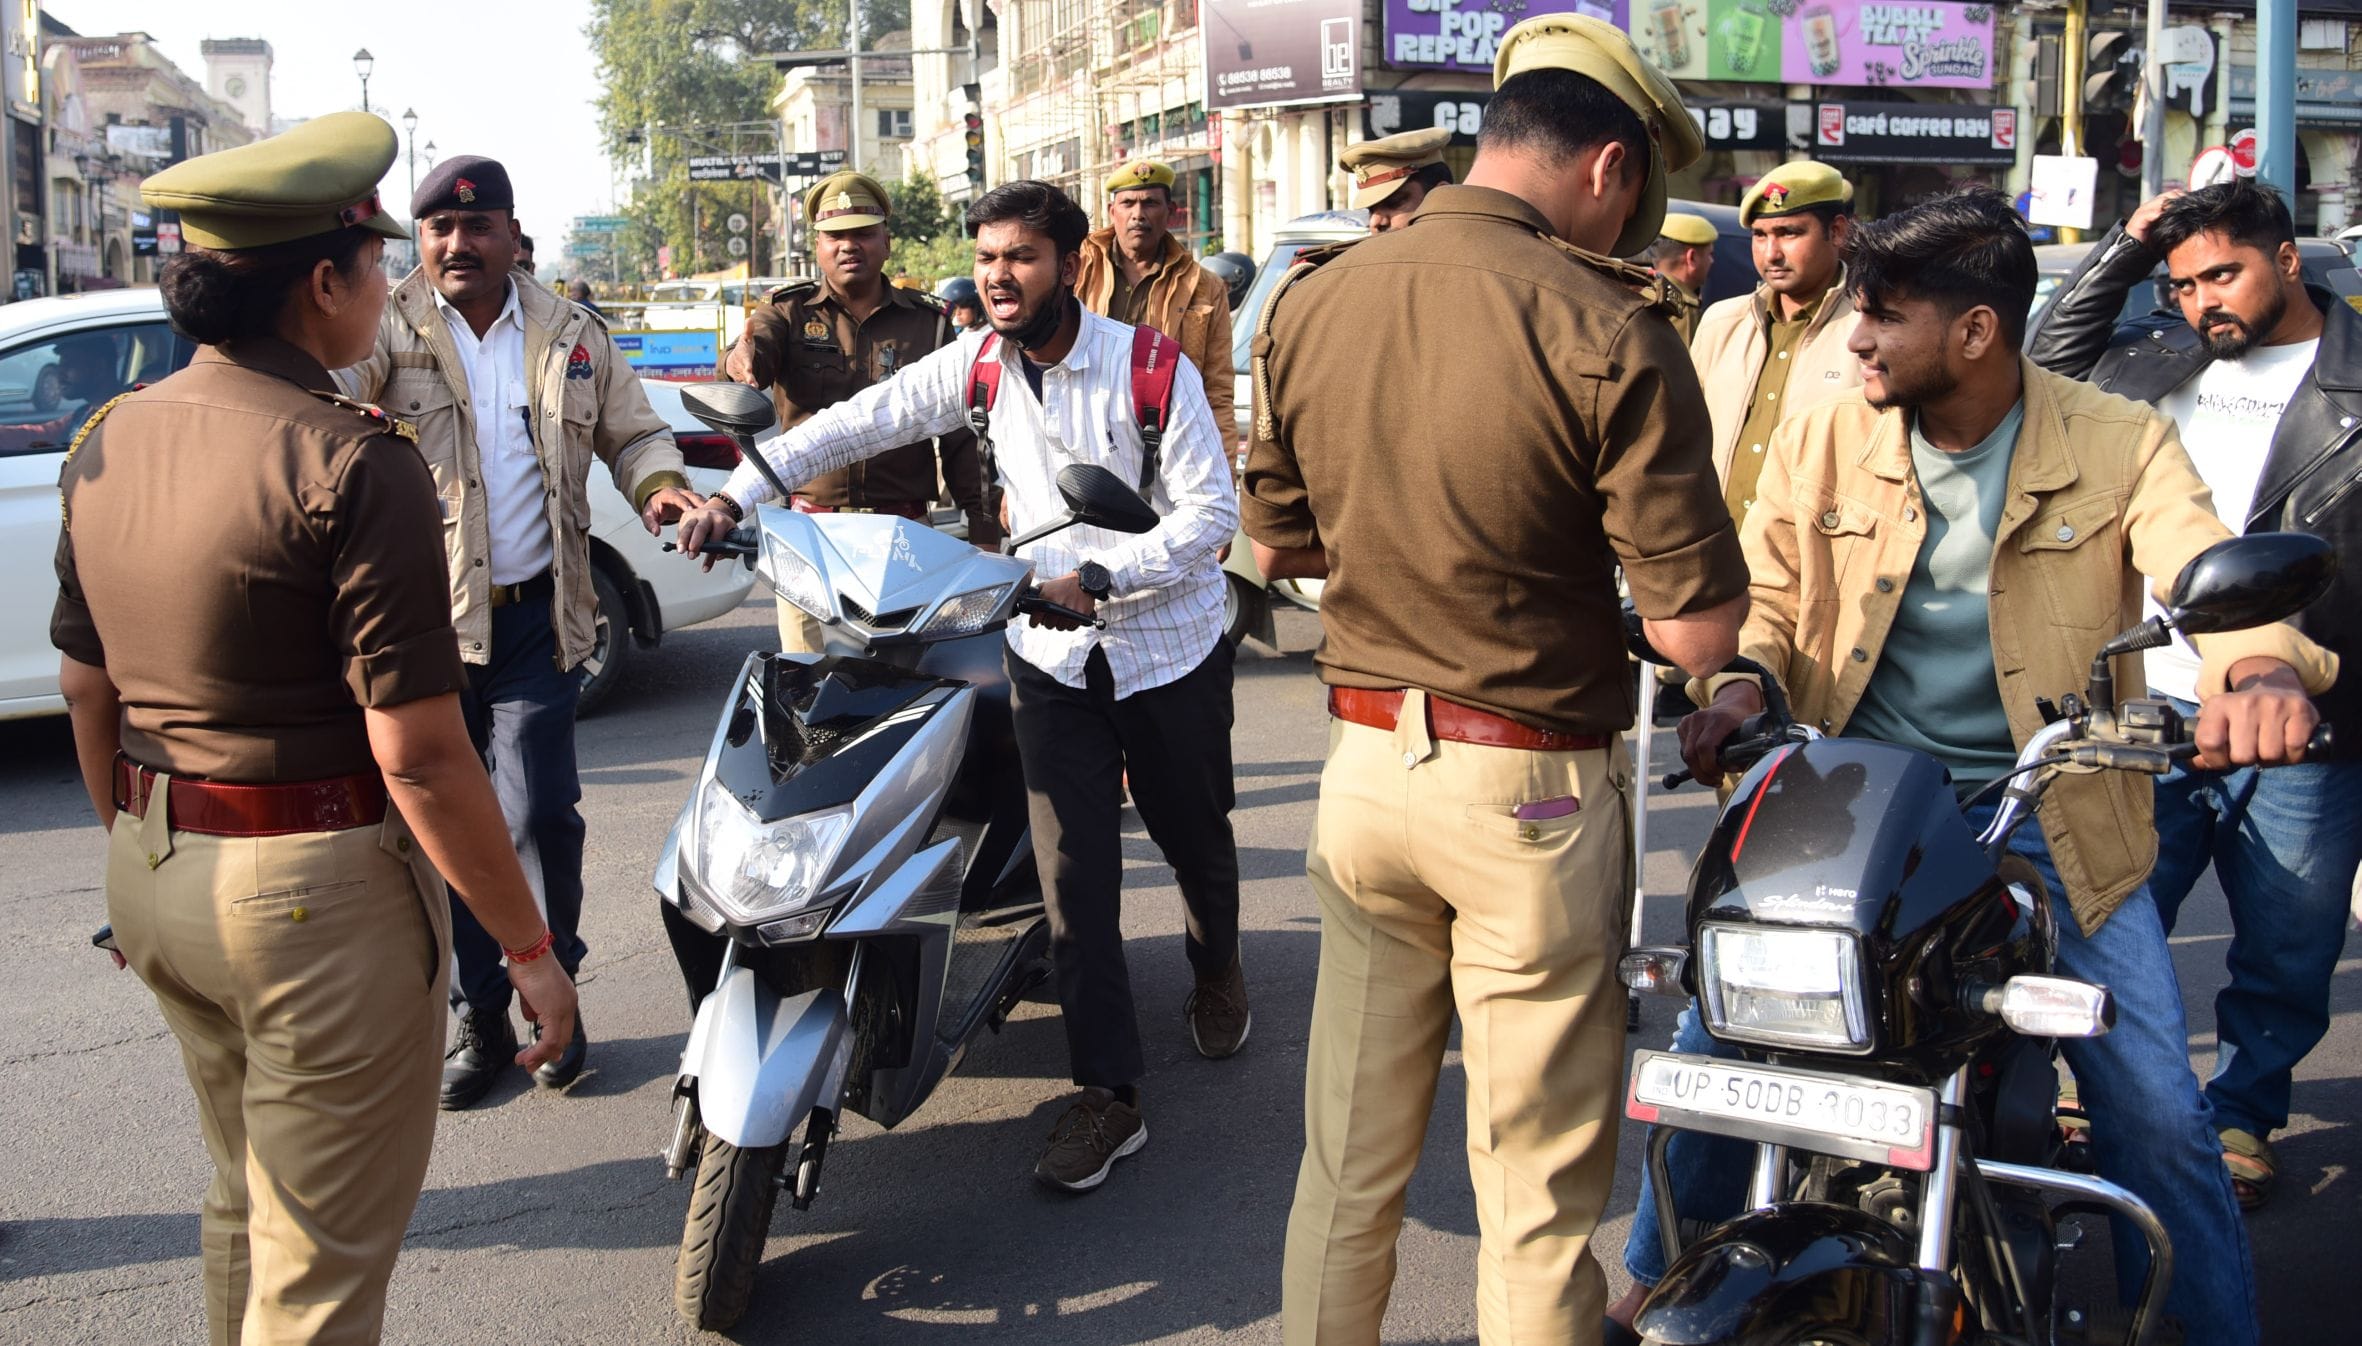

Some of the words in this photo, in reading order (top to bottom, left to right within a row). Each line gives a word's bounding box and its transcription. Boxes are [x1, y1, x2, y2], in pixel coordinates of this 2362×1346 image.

[1440, 10, 1505, 40] POP
[1860, 5, 1944, 29] BUBBLE
[1394, 33, 1500, 64] REPEA
[1863, 25, 1900, 45] TEA
[1902, 26, 1933, 45] AT
[1901, 37, 1984, 80] Sprinkle
[1929, 65, 1982, 79] SUNDAES
[1673, 1069, 1711, 1101] UP
